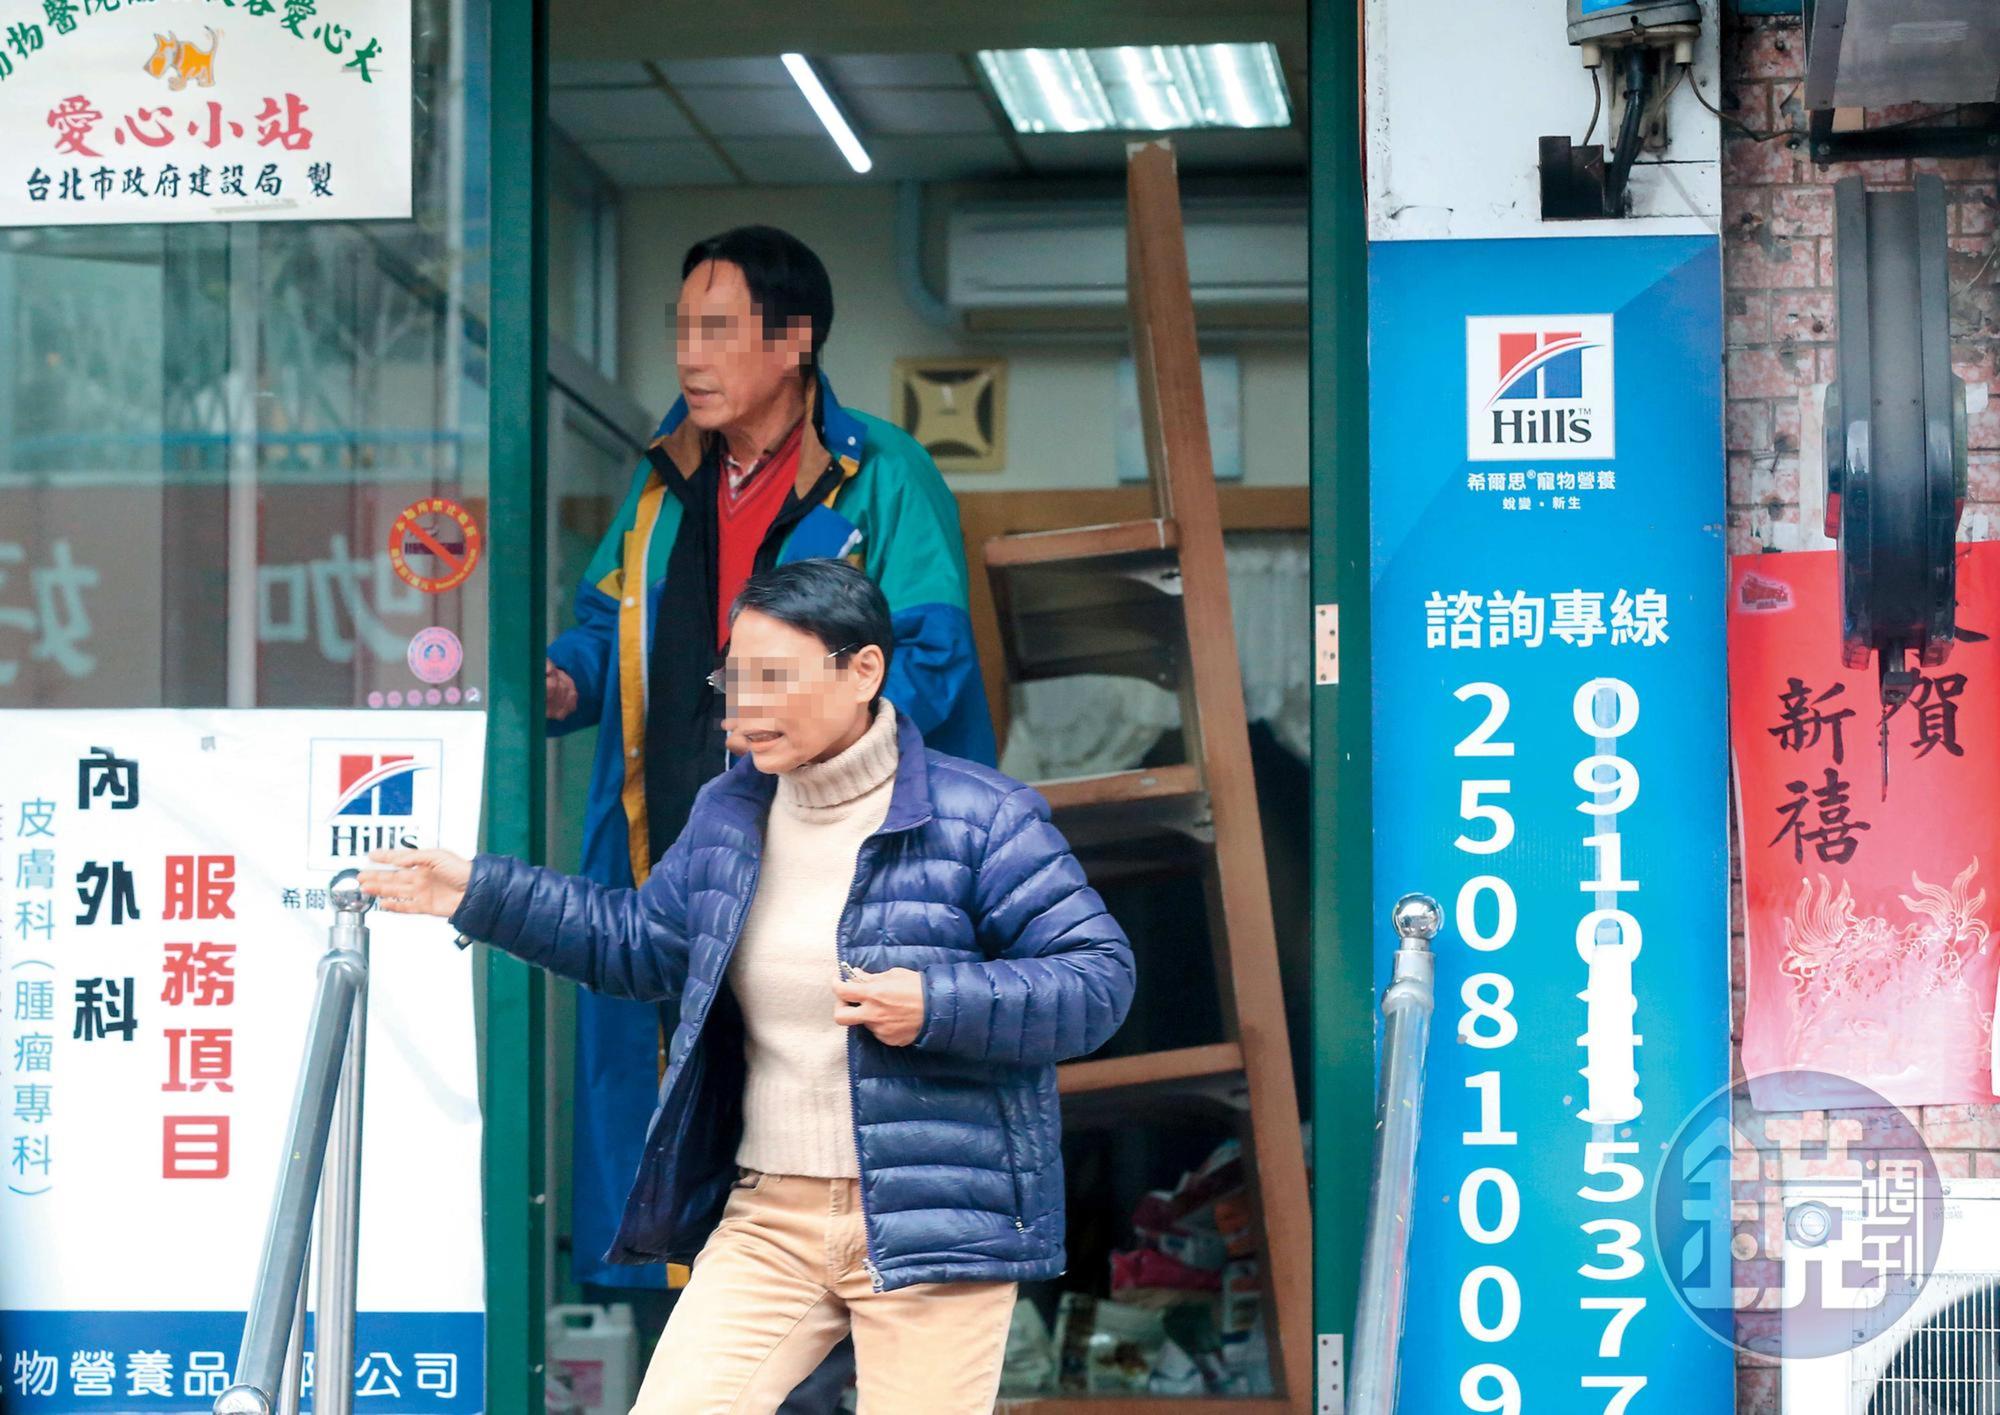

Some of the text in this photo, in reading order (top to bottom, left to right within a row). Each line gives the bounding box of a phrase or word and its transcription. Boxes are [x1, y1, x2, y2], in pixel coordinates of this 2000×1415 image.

[46, 93, 314, 157] 愛心小站
[26, 162, 334, 201] 台北市政府建設局 製
[1492, 408, 1592, 444] Hill's
[1424, 588, 1670, 649] 諮詢專線
[1768, 677, 1871, 865] 新禧
[73, 746, 140, 1042] 內外科
[161, 855, 237, 1179] 服務項目
[1453, 681, 1522, 1415] 25081009
[0, 1349, 458, 1399] 物營養品公司
